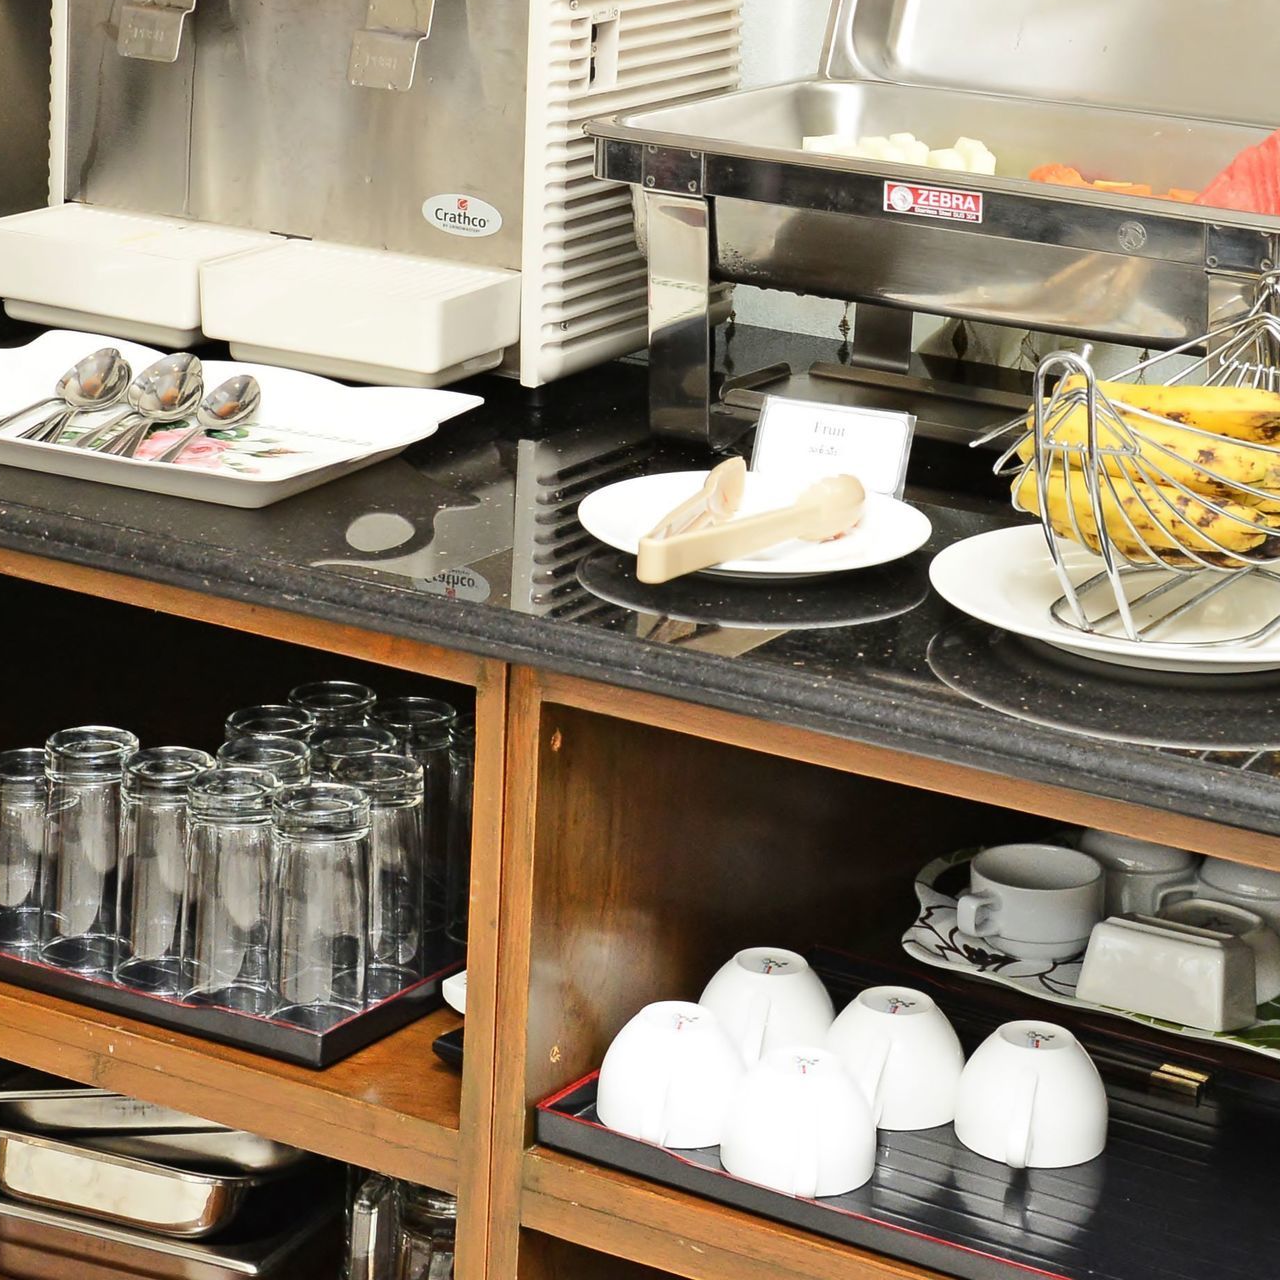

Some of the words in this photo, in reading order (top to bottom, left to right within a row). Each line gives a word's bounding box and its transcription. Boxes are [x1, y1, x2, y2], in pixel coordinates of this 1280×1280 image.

[917, 189, 976, 211] ZEBRA
[434, 207, 487, 228] Crathco
[813, 420, 846, 437] Fruit
